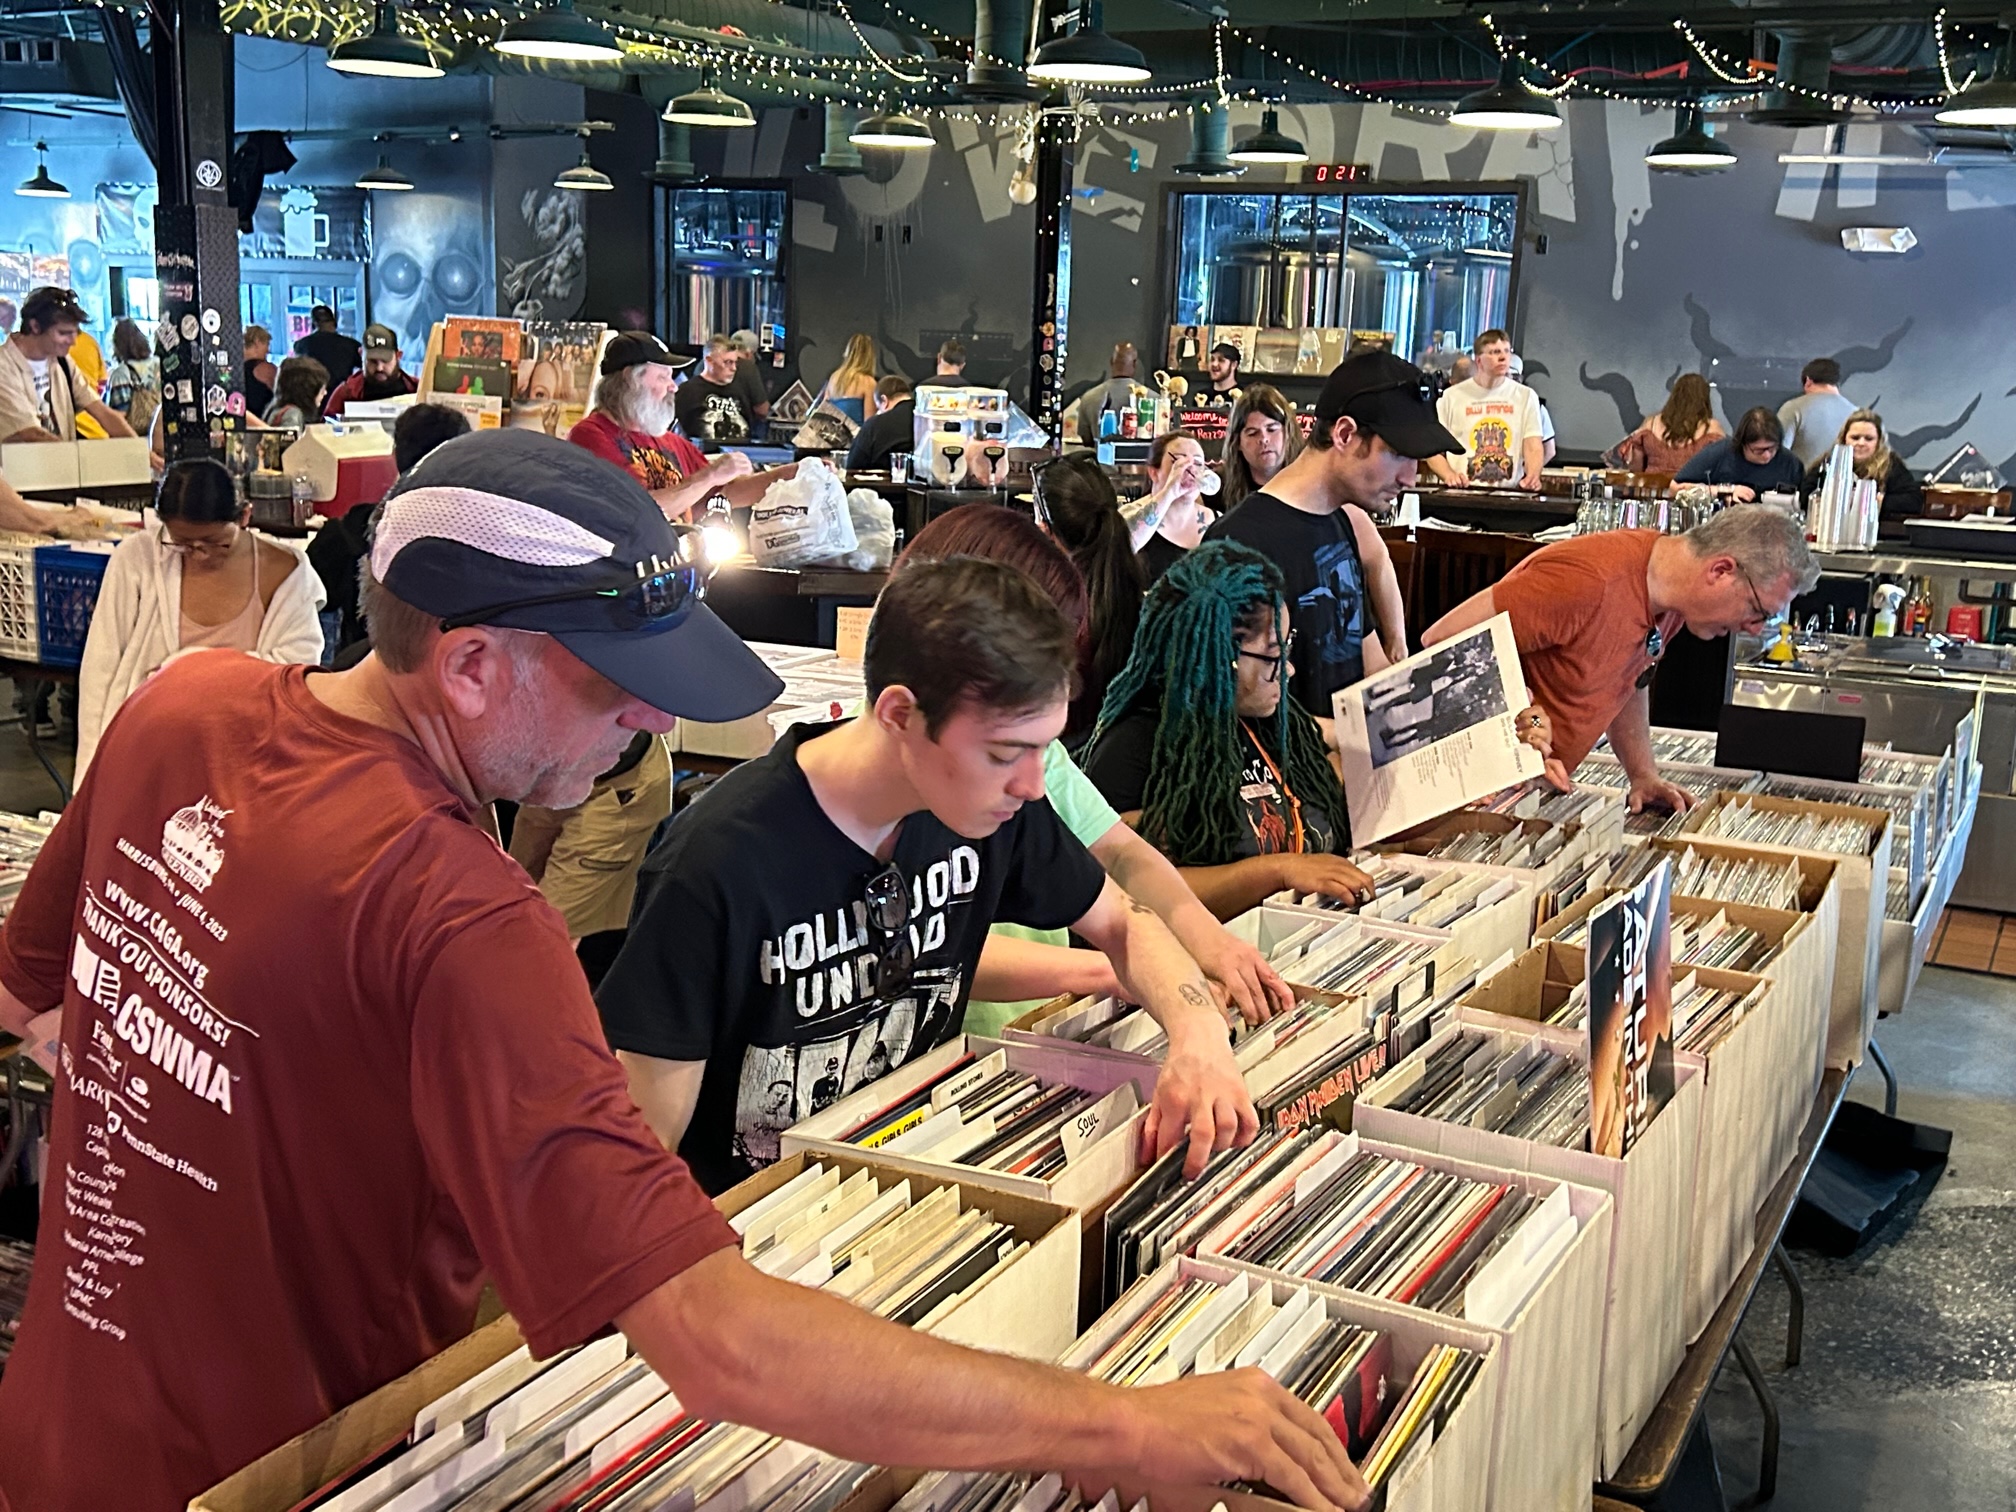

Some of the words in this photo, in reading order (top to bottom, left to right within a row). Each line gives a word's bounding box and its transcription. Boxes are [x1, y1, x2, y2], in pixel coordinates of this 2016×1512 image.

[176, 893, 203, 914] JUNE
[205, 917, 229, 942] 2023
[144, 961, 231, 1048] SPONSORS!
[113, 994, 232, 1115] CSWMA
[950, 1081, 968, 1097] ROLLING
[1077, 1112, 1099, 1137] SOUL
